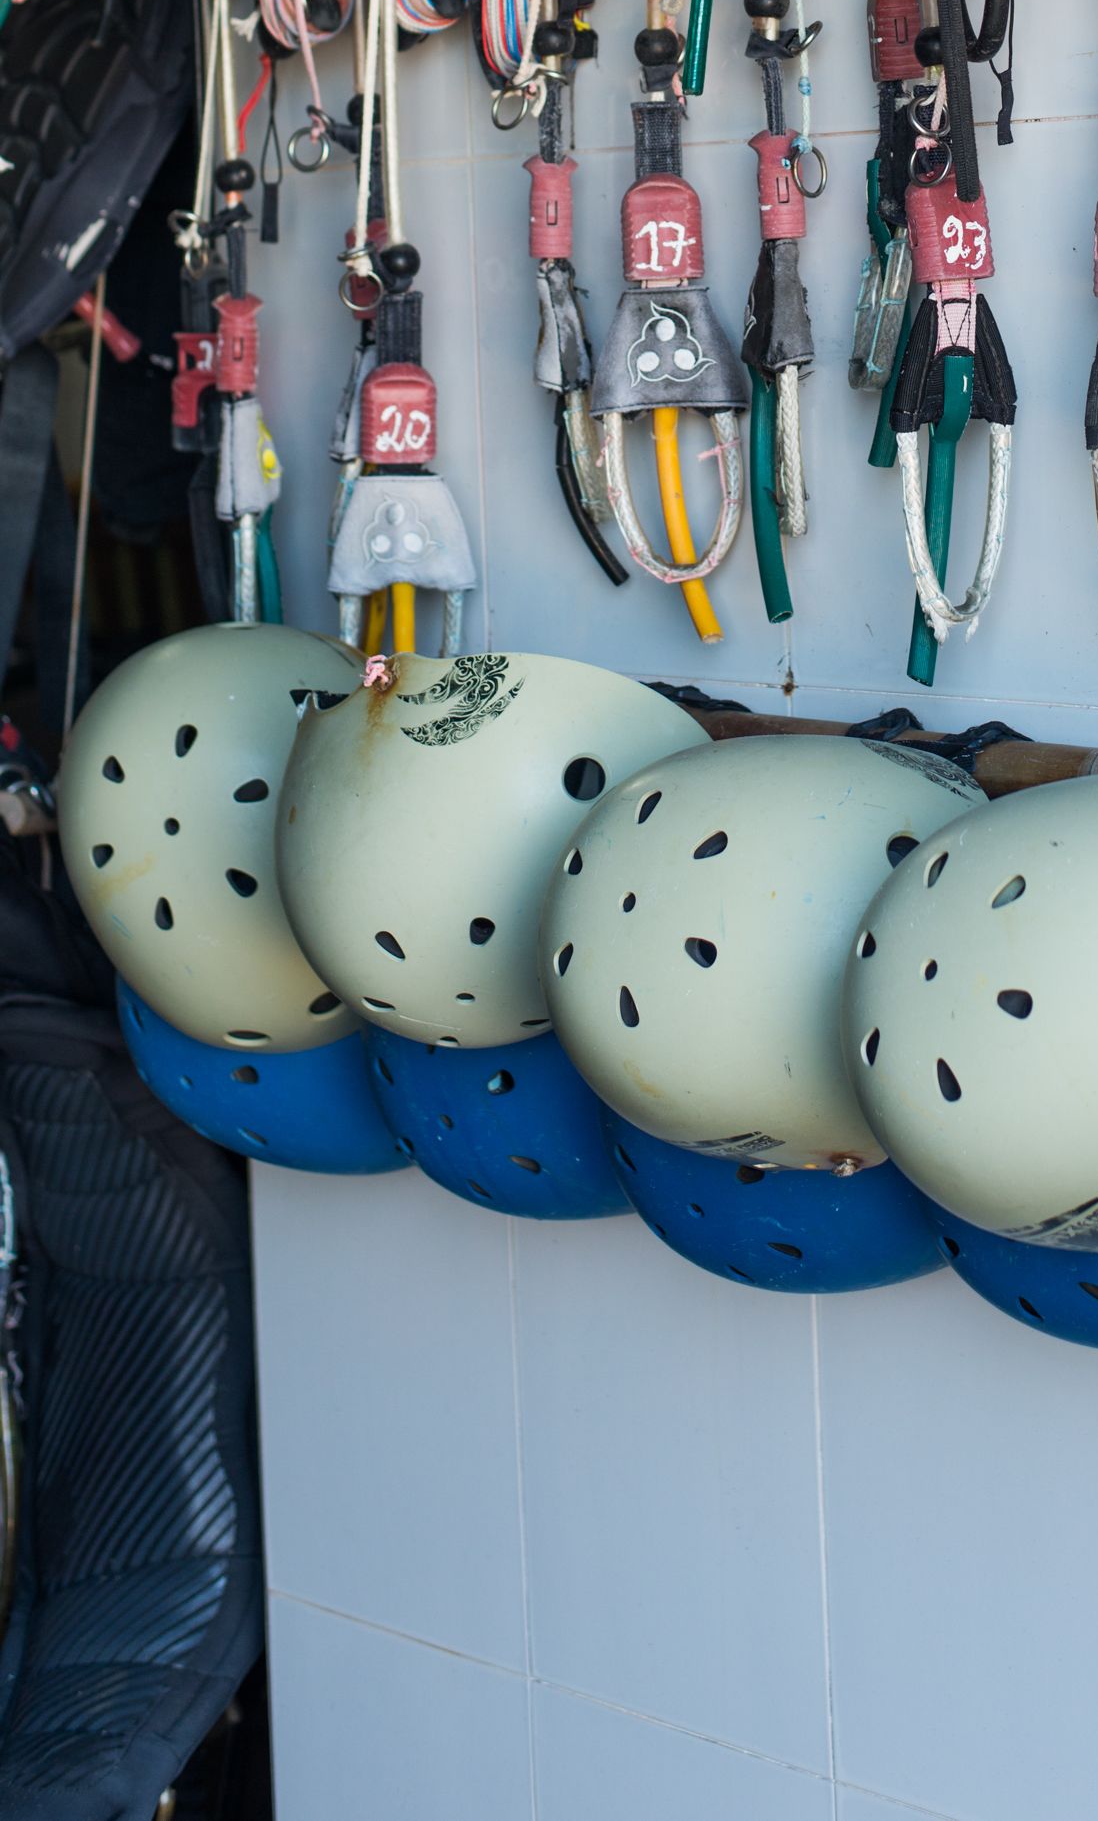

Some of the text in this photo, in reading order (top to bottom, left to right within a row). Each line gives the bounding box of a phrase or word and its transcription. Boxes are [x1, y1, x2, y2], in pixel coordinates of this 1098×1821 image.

[635, 220, 697, 272] 17
[942, 215, 987, 270] 23
[375, 405, 431, 452] 20
